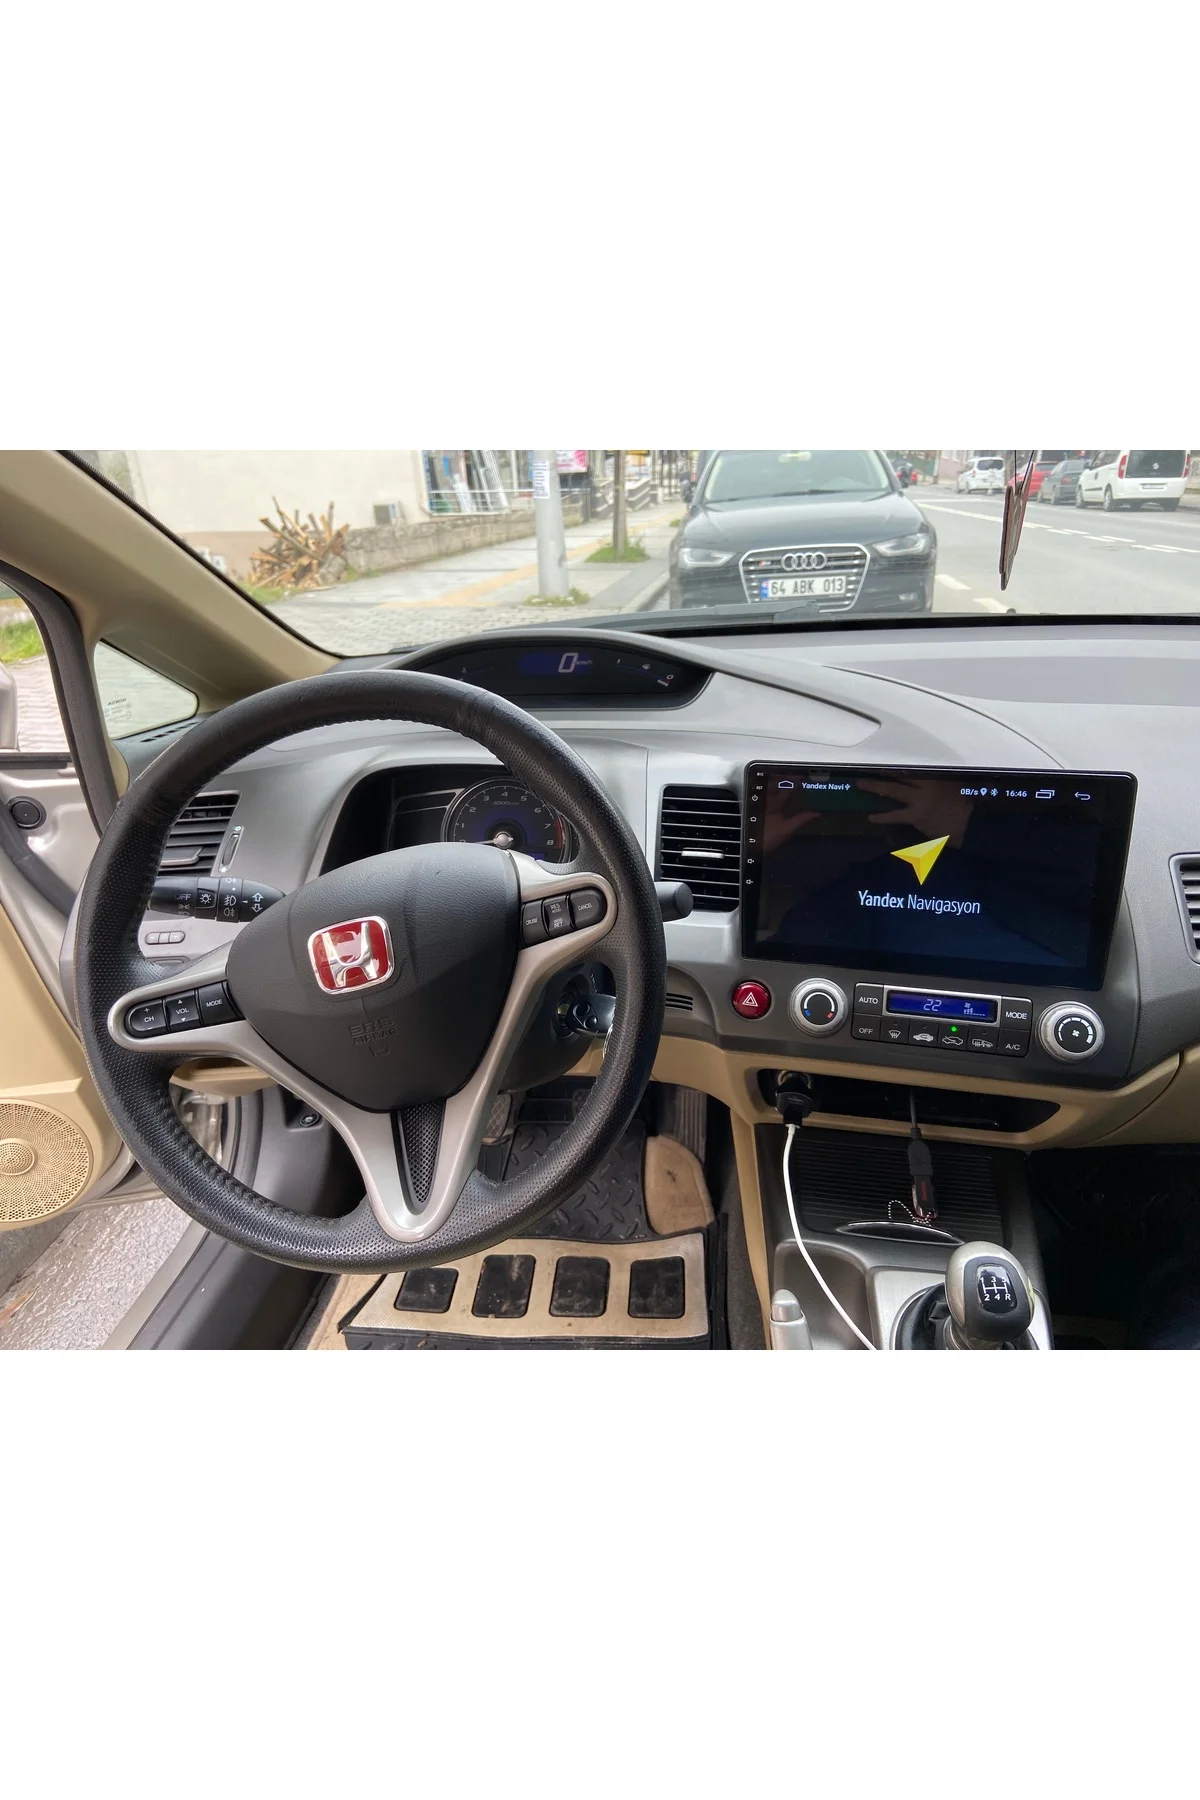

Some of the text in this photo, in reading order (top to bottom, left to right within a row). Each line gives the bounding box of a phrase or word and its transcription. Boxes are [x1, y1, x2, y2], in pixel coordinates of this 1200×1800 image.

[771, 578, 844, 596] 64 ABK 013
[558, 652, 579, 673] 0
[801, 782, 844, 791] Yandex Navi
[960, 788, 979, 796] 0B/s
[1005, 789, 1028, 797] 16:46
[577, 902, 593, 911] CANCEL
[858, 890, 981, 915] Yandex Navigasyon
[206, 998, 222, 1007] MODE
[858, 996, 878, 1005] AUTO
[923, 998, 942, 1012] 22
[175, 1007, 190, 1015] VOL
[1005, 1011, 1028, 1020] MODE
[858, 1027, 874, 1035] OFF
[1005, 1293, 1012, 1301] R
